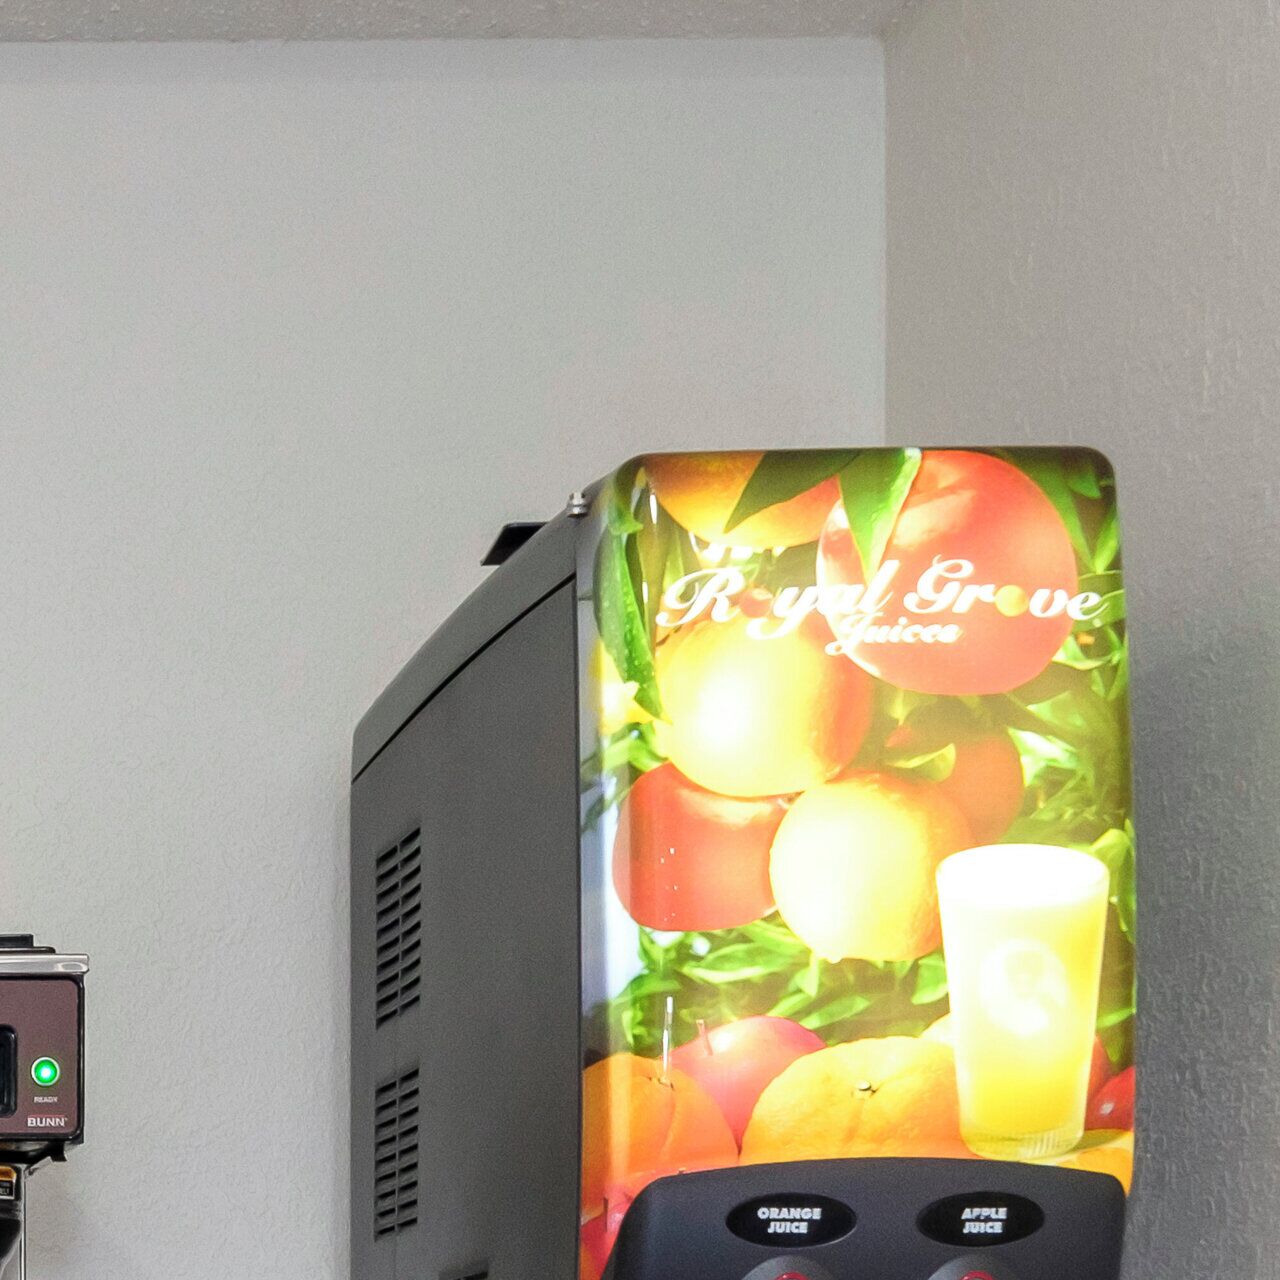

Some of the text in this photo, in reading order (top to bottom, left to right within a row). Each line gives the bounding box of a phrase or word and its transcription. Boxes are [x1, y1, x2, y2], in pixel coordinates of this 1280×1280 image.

[904, 555, 1107, 621] Grove
[27, 1118, 65, 1127] BUNN
[757, 1208, 822, 1220] ORANGE
[961, 1208, 1007, 1219] APPLE
[768, 1222, 808, 1233] JUICE
[963, 1222, 1003, 1233] JUICE
